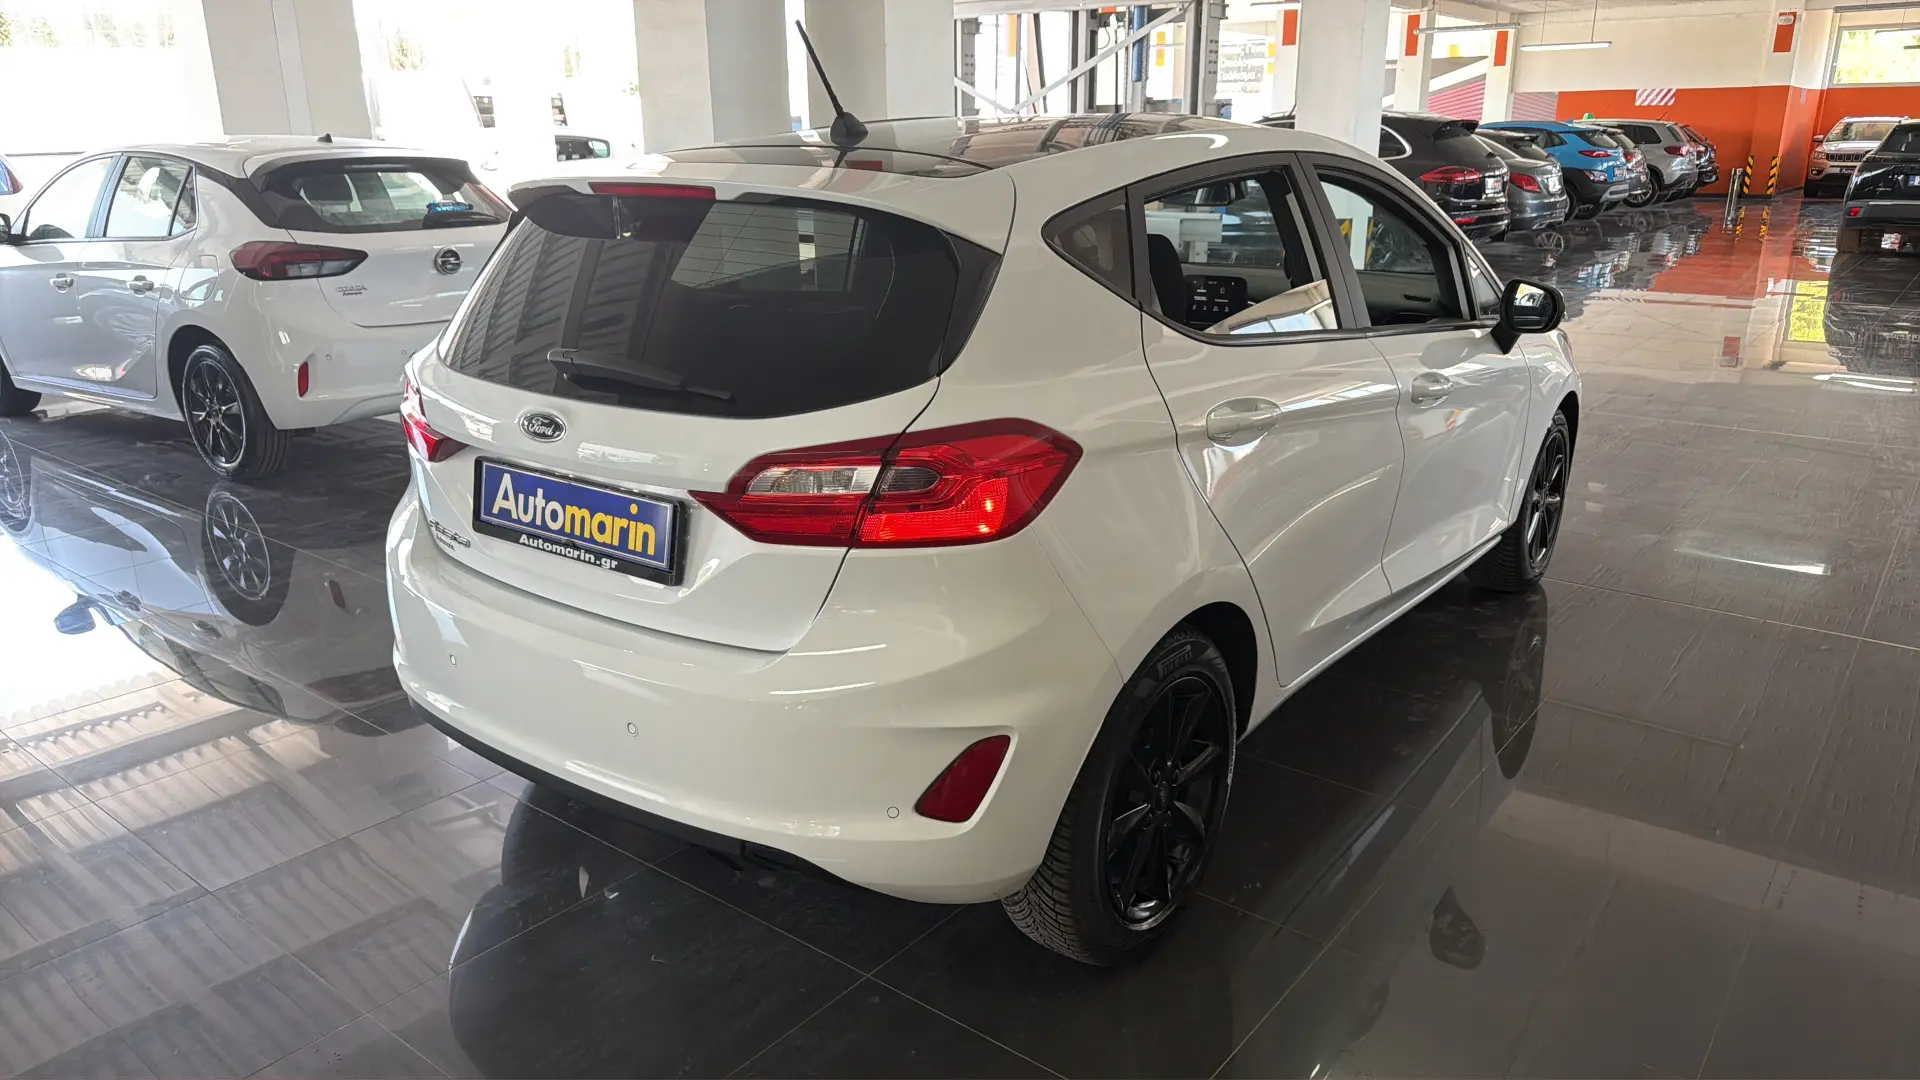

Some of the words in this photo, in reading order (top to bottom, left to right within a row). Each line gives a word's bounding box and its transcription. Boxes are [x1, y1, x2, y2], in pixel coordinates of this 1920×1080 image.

[529, 417, 555, 436] Ford
[492, 473, 656, 556] Automarin
[519, 533, 619, 570] Automarin.gr
[1156, 645, 1192, 681] PIRELLI
